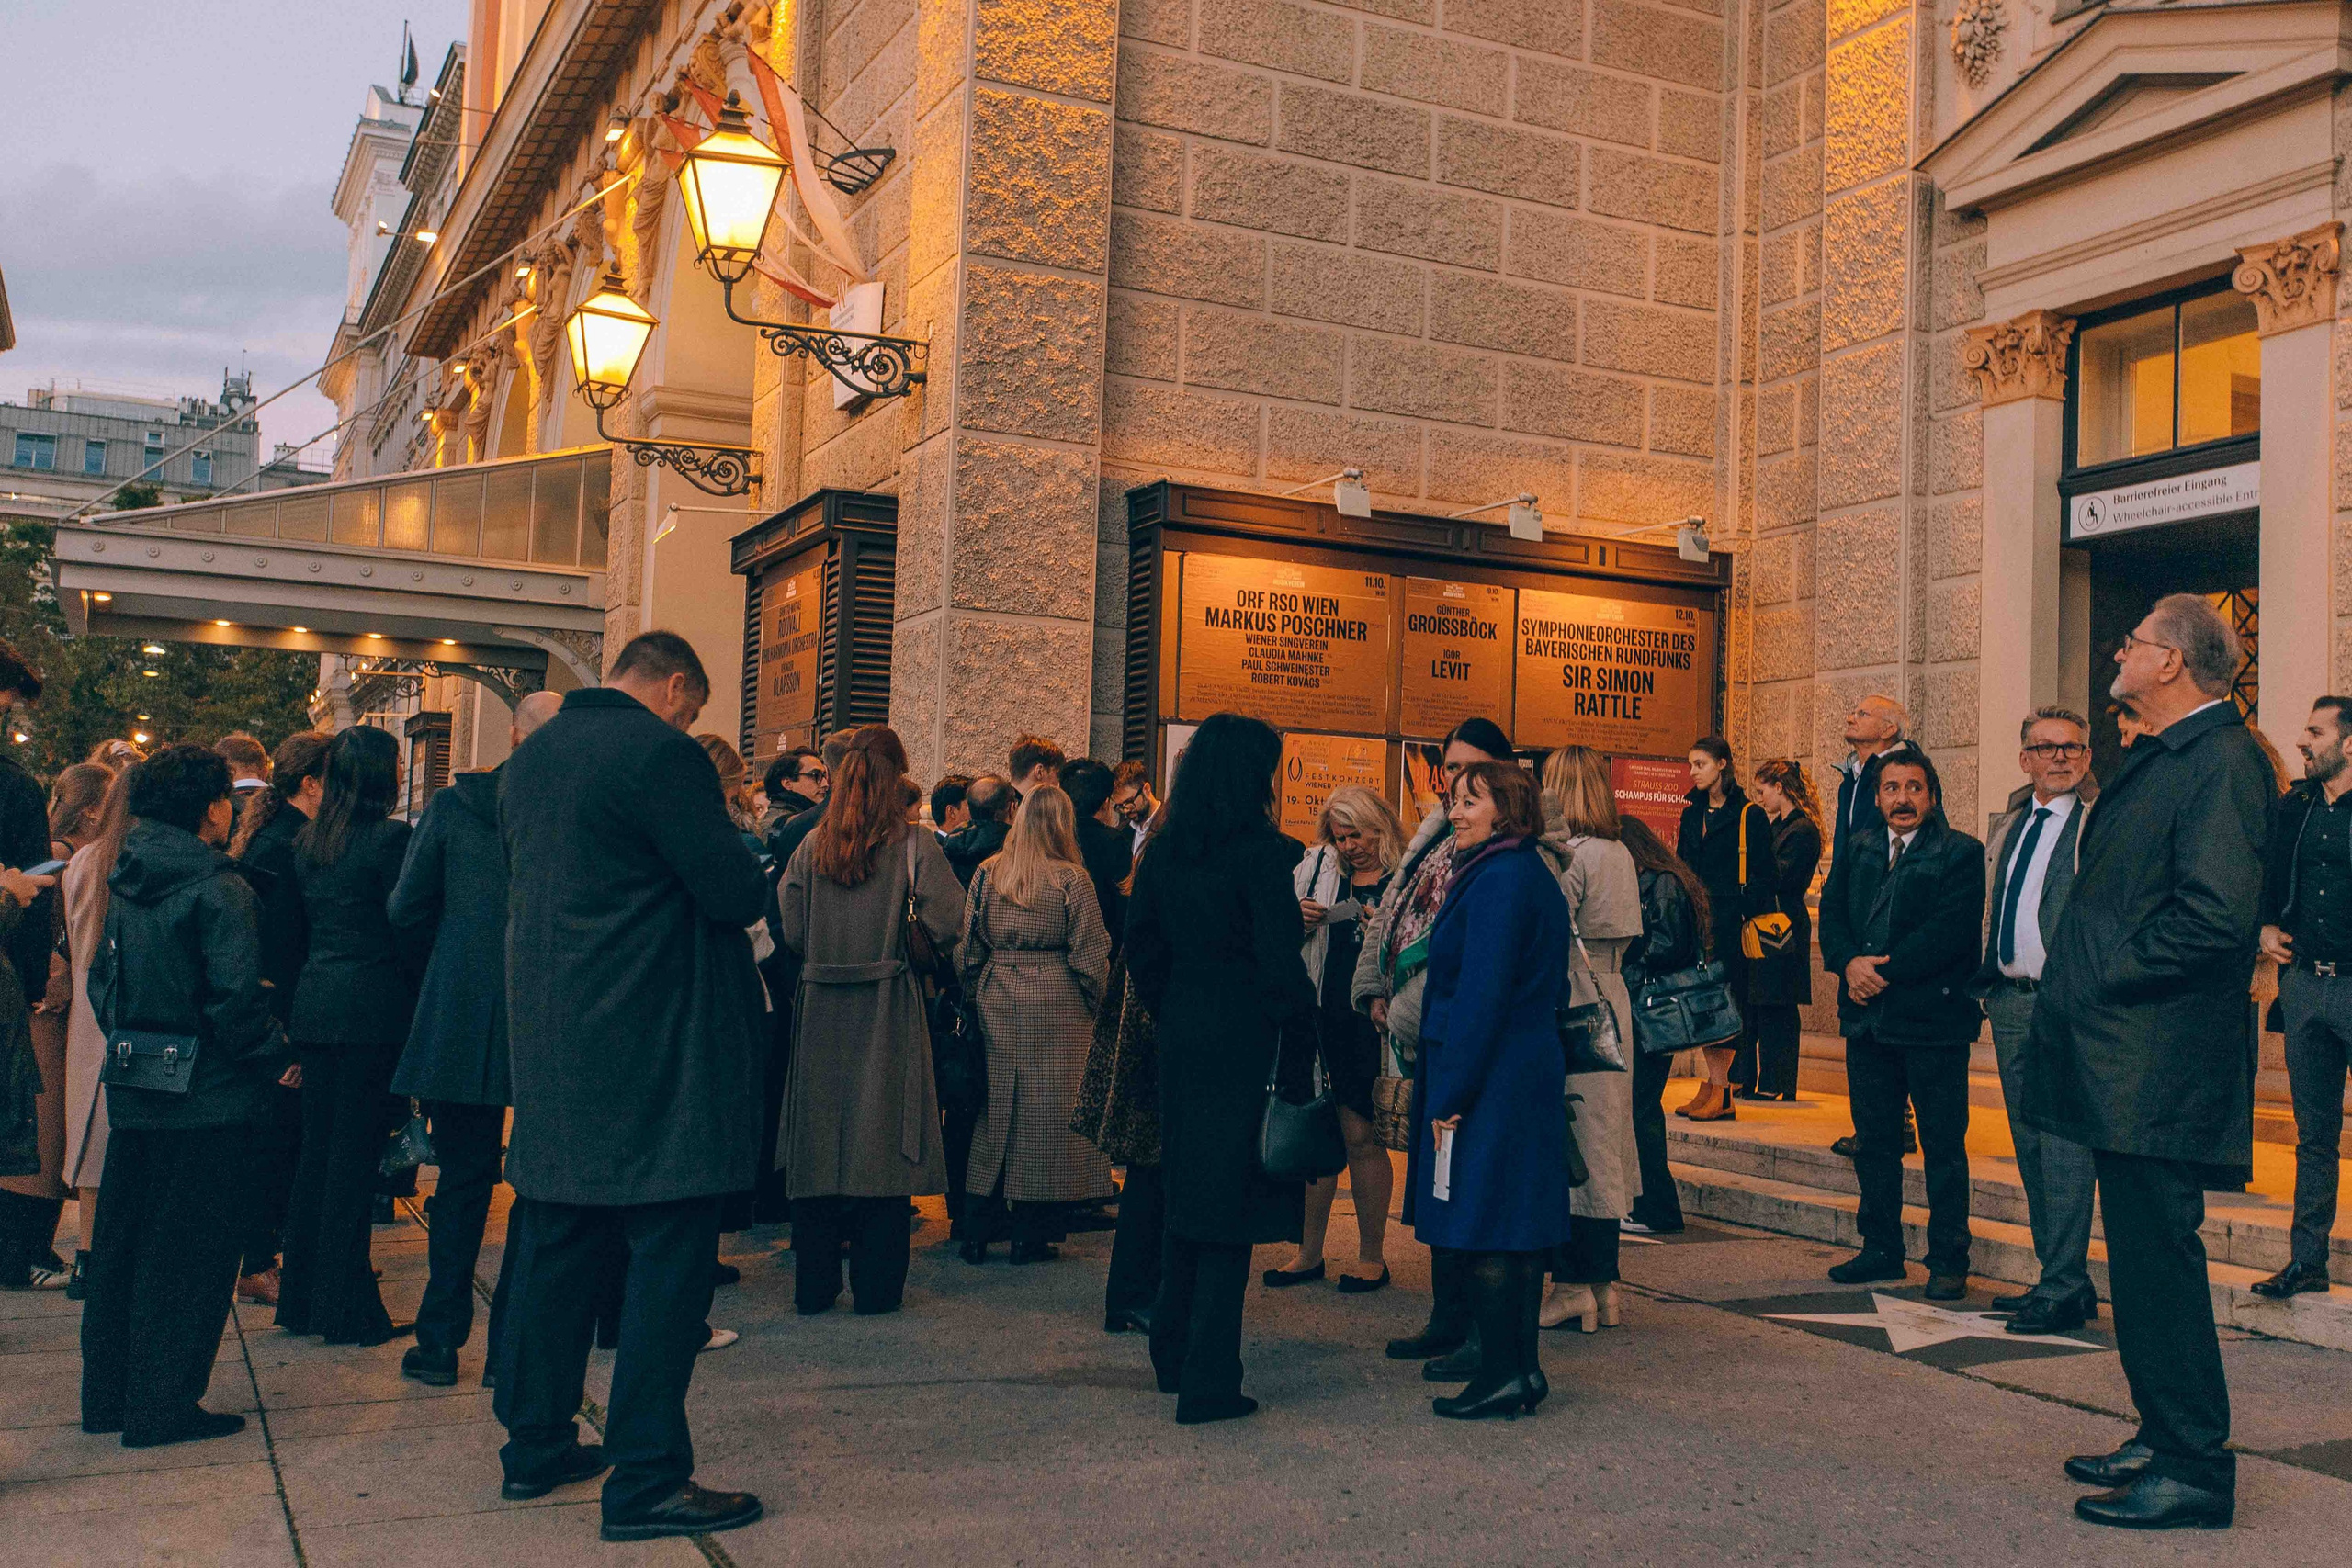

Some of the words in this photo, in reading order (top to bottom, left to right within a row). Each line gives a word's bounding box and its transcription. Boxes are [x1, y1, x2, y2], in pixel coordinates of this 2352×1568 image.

[2113, 484, 2180, 504] Barrierefreier
[2185, 476, 2227, 491] Eingang
[2113, 493, 2233, 524] Wheelchair-accessible
[1364, 575, 1386, 590] 11.10.
[1237, 590, 1265, 609] ORF
[1269, 592, 1298, 612] RSO
[1303, 596, 1339, 616] WIEN
[1436, 604, 1470, 618] GÜNTHER
[1205, 607, 1276, 632] MARKUS
[1281, 615, 1367, 641] POSCHNER
[1675, 609, 1696, 622] 12.10.
[1408, 613, 1497, 640] GROISSBÖCK
[1521, 617, 1670, 649] SYMPHONIEORCHESTER
[1672, 633, 1695, 651] DES
[1245, 633, 1277, 647] WIENER
[1279, 636, 1329, 650] SINGVEREIN
[1249, 647, 1286, 660] CLAUDIA
[1288, 650, 1324, 663] MAHNKE
[1443, 649, 1461, 660] IGOR
[1525, 637, 1613, 663] BAYERISCHEN
[1616, 648, 1690, 671] RUNDFUNKS
[1242, 659, 1263, 671] PAUL
[1265, 660, 1329, 676] SCHWEINESTER
[1431, 660, 1471, 681] LEVIT
[1251, 672, 1284, 686] ROBERT
[1287, 671, 1320, 688] KOVÁCS
[1563, 664, 1592, 690] SIR
[1596, 668, 1654, 694] SIMON
[1574, 692, 1642, 720] RATTLE
[1305, 773, 1380, 784] FESTKONZERT
[1633, 780, 1663, 791] STRAUSS
[1664, 782, 1679, 792] 200
[1286, 795, 1300, 806] 19.
[1614, 789, 1653, 801] SCHAMPUS
[1653, 791, 1667, 802] FÜR
[1668, 795, 1692, 805] SCHA
[1308, 807, 1318, 816] 15
